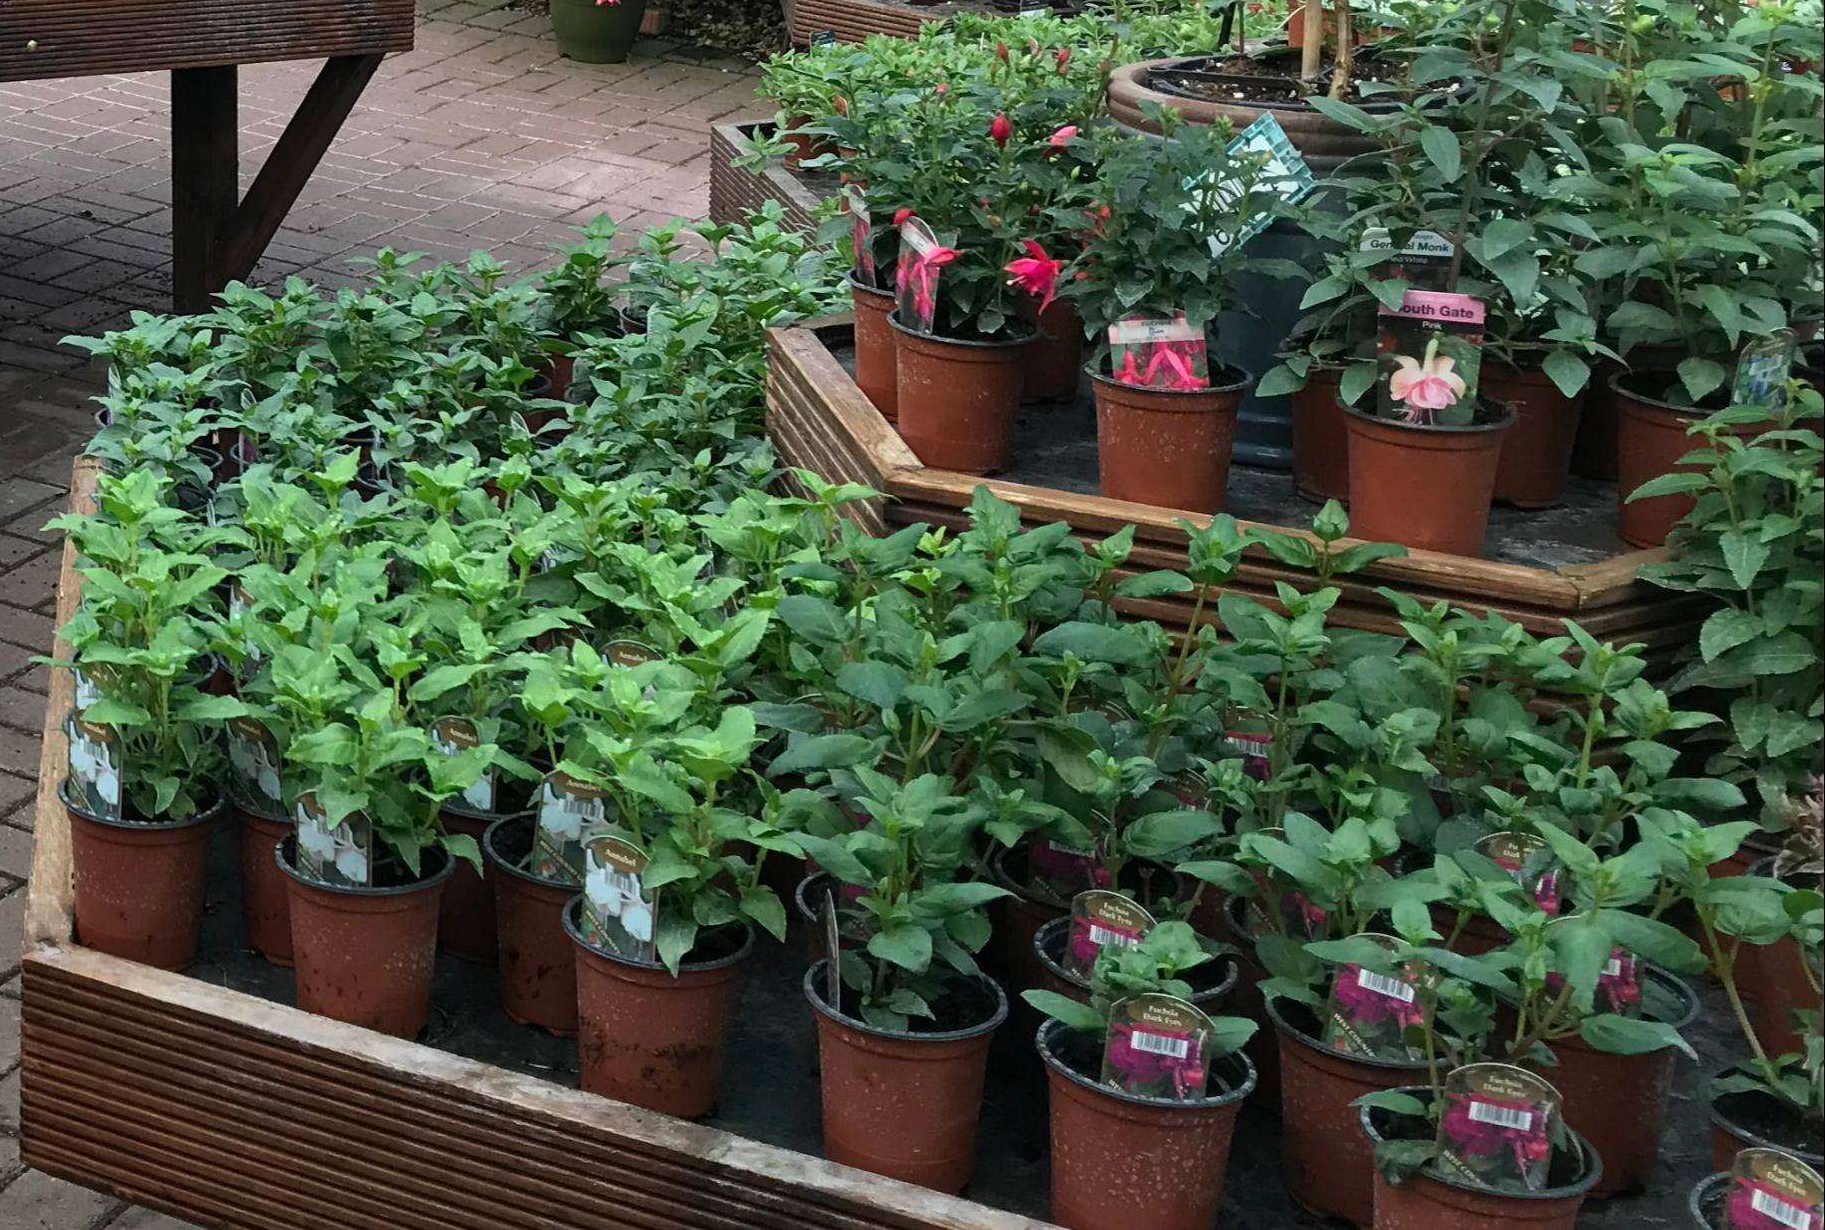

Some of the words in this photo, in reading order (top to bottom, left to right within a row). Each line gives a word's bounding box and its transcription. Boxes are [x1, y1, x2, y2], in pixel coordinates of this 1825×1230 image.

[1417, 242, 1449, 252] Monk
[1401, 303, 1434, 315] outh
[1439, 305, 1474, 319] Gate
[1422, 320, 1442, 330] Pink
[606, 848, 636, 867] Annabel
[1099, 909, 1116, 919] Dark
[1149, 1005, 1179, 1017] Fuchsia
[1143, 1013, 1162, 1023] Dark
[1164, 1016, 1182, 1027] Eyes
[1333, 1012, 1350, 1030] WEST
[1483, 1082, 1505, 1093] Dark
[1489, 1075, 1523, 1088] Fuchsia
[1767, 1171, 1786, 1186] Dark
[1774, 1164, 1803, 1184] Fuchsia
